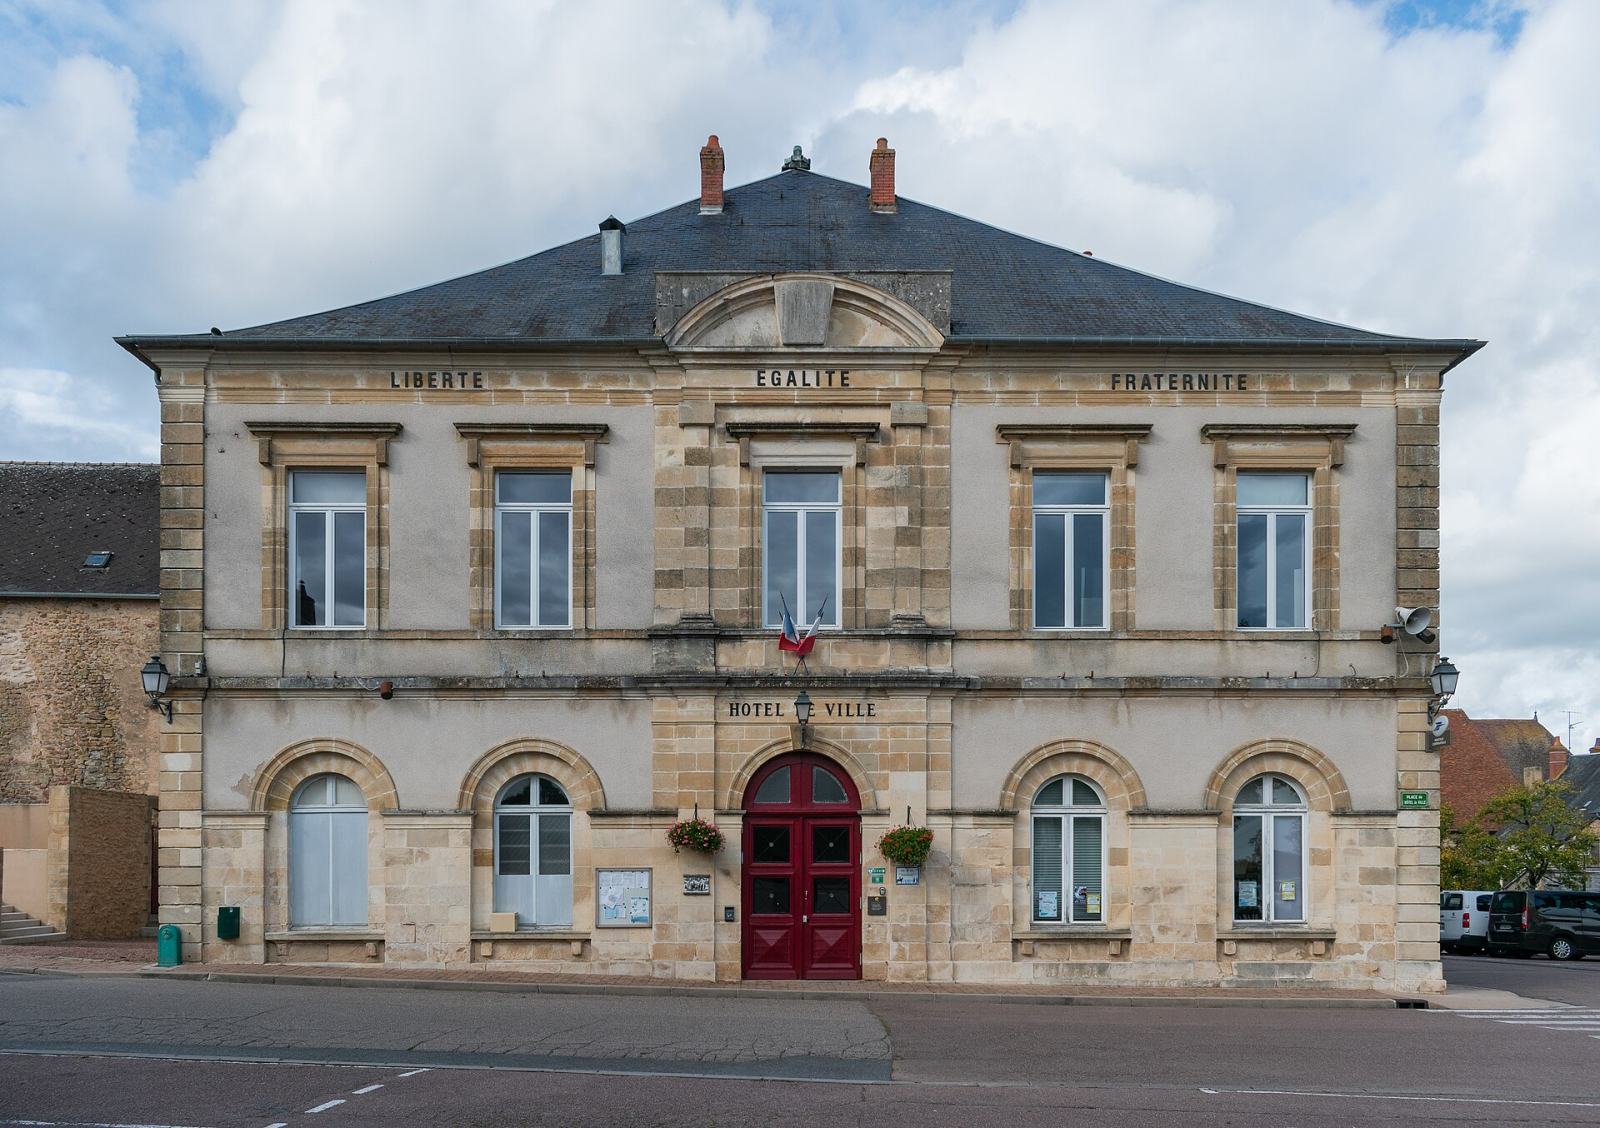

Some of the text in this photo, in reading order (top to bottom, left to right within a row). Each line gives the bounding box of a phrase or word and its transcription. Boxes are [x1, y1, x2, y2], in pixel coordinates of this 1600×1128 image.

[390, 371, 483, 388] LIBERTE
[756, 370, 850, 387] EGALITE
[1111, 373, 1247, 391] FRATERNITE
[729, 702, 877, 717] HOTEL E VILLE
